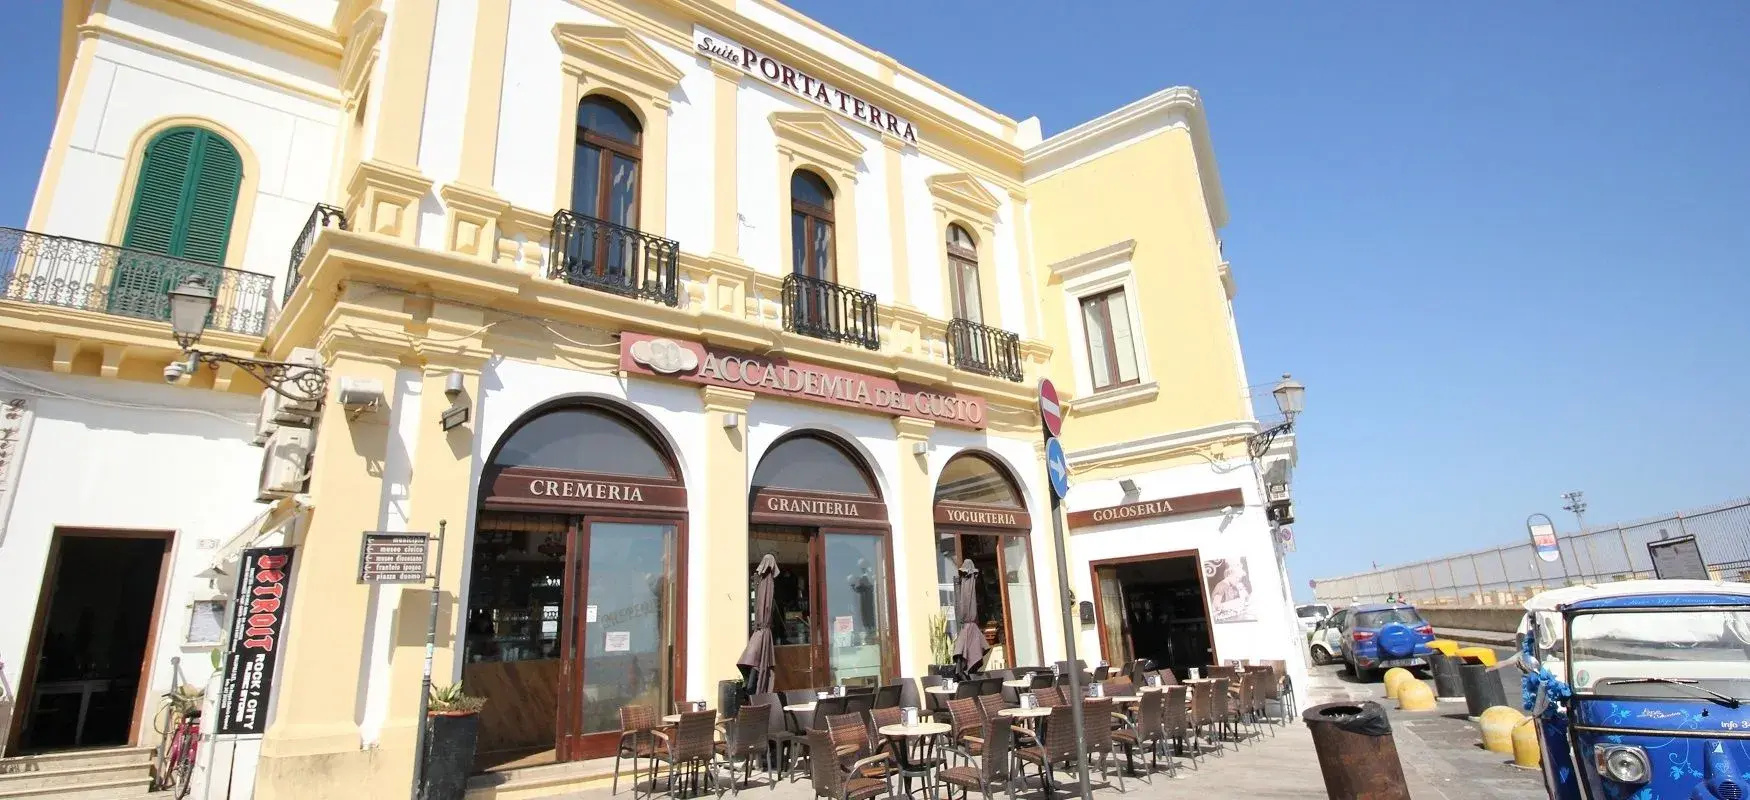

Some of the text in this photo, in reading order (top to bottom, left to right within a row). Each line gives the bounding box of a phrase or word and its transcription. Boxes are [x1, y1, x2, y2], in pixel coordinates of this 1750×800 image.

[697, 36, 918, 144] Suite PORTA TERRA
[698, 352, 983, 424] ACCADEMIA DEL GUSTO
[529, 479, 644, 502] CREMERIA
[767, 497, 859, 516] GRANITERIA
[947, 509, 1017, 525] YOGURTERIA
[1092, 499, 1174, 522] GOLOSERIA
[404, 545, 424, 553] civico
[243, 554, 289, 652] DETROIT
[243, 653, 266, 730] ROCK CITY
